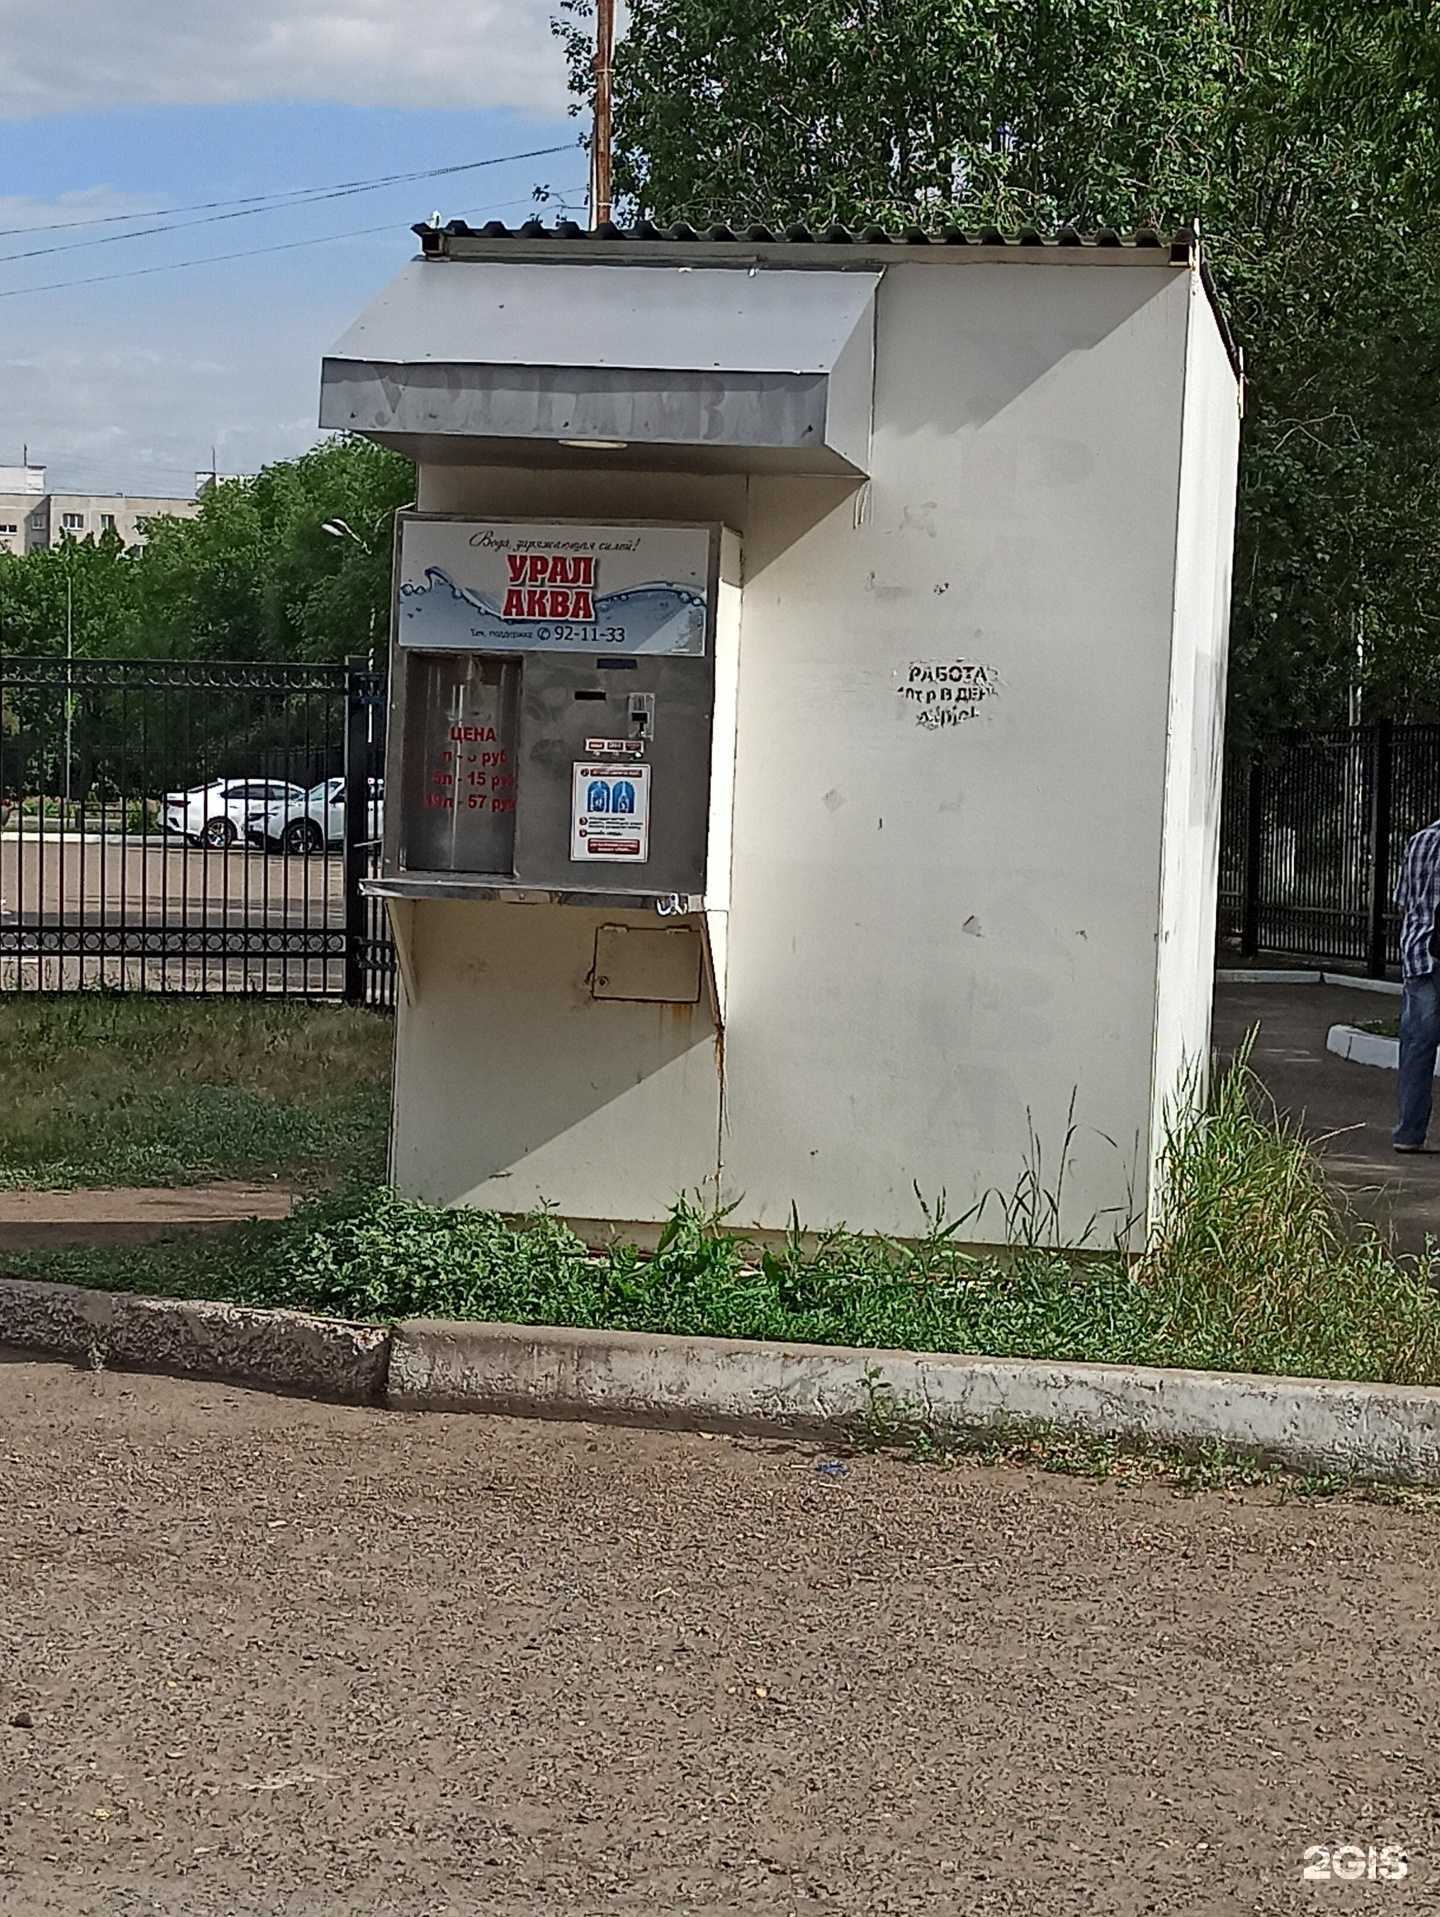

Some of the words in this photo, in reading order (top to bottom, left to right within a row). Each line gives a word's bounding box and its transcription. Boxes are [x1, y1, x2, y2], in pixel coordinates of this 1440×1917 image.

[506, 554, 594, 586] УРАЛ
[502, 588, 594, 620] АКВА
[553, 625, 626, 643] 92-11-33
[908, 666, 988, 683] РАБОТА
[450, 726, 497, 744] ЦЕНА
[467, 771, 486, 786] 15
[468, 793, 487, 809] 57
